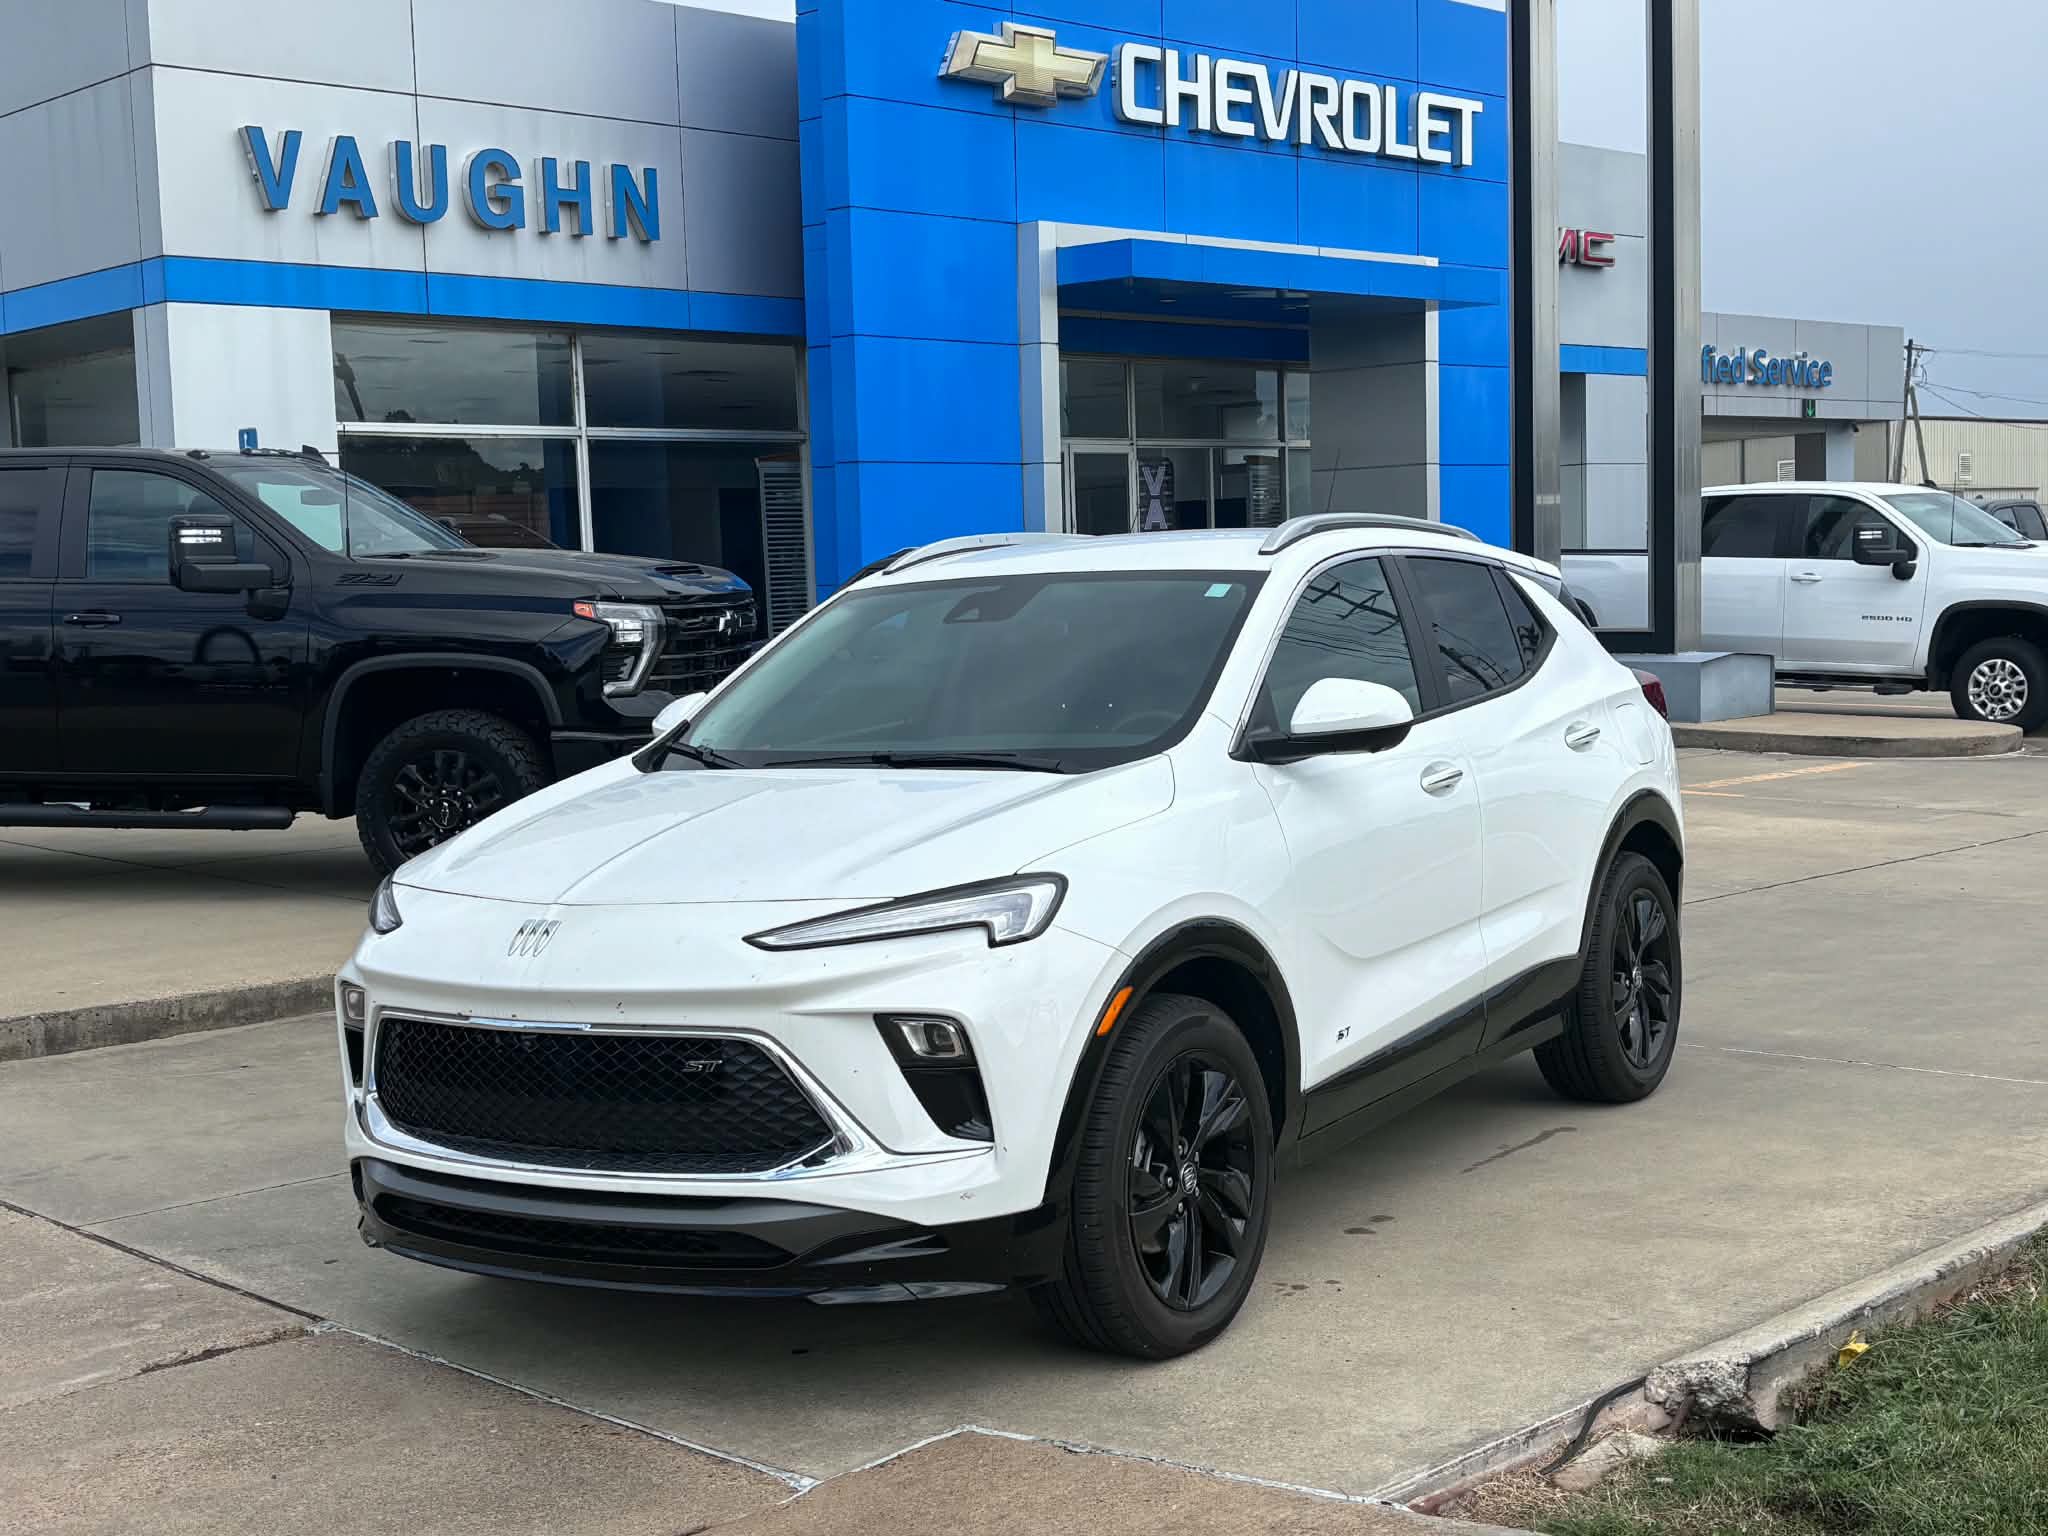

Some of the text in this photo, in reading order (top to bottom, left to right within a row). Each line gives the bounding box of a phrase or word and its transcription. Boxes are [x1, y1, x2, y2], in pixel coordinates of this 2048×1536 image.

[1115, 42, 1483, 167] CHEVROLET
[238, 126, 660, 242] VAUGHN
[1752, 349, 1832, 388] Service
[681, 1060, 723, 1073] ST
